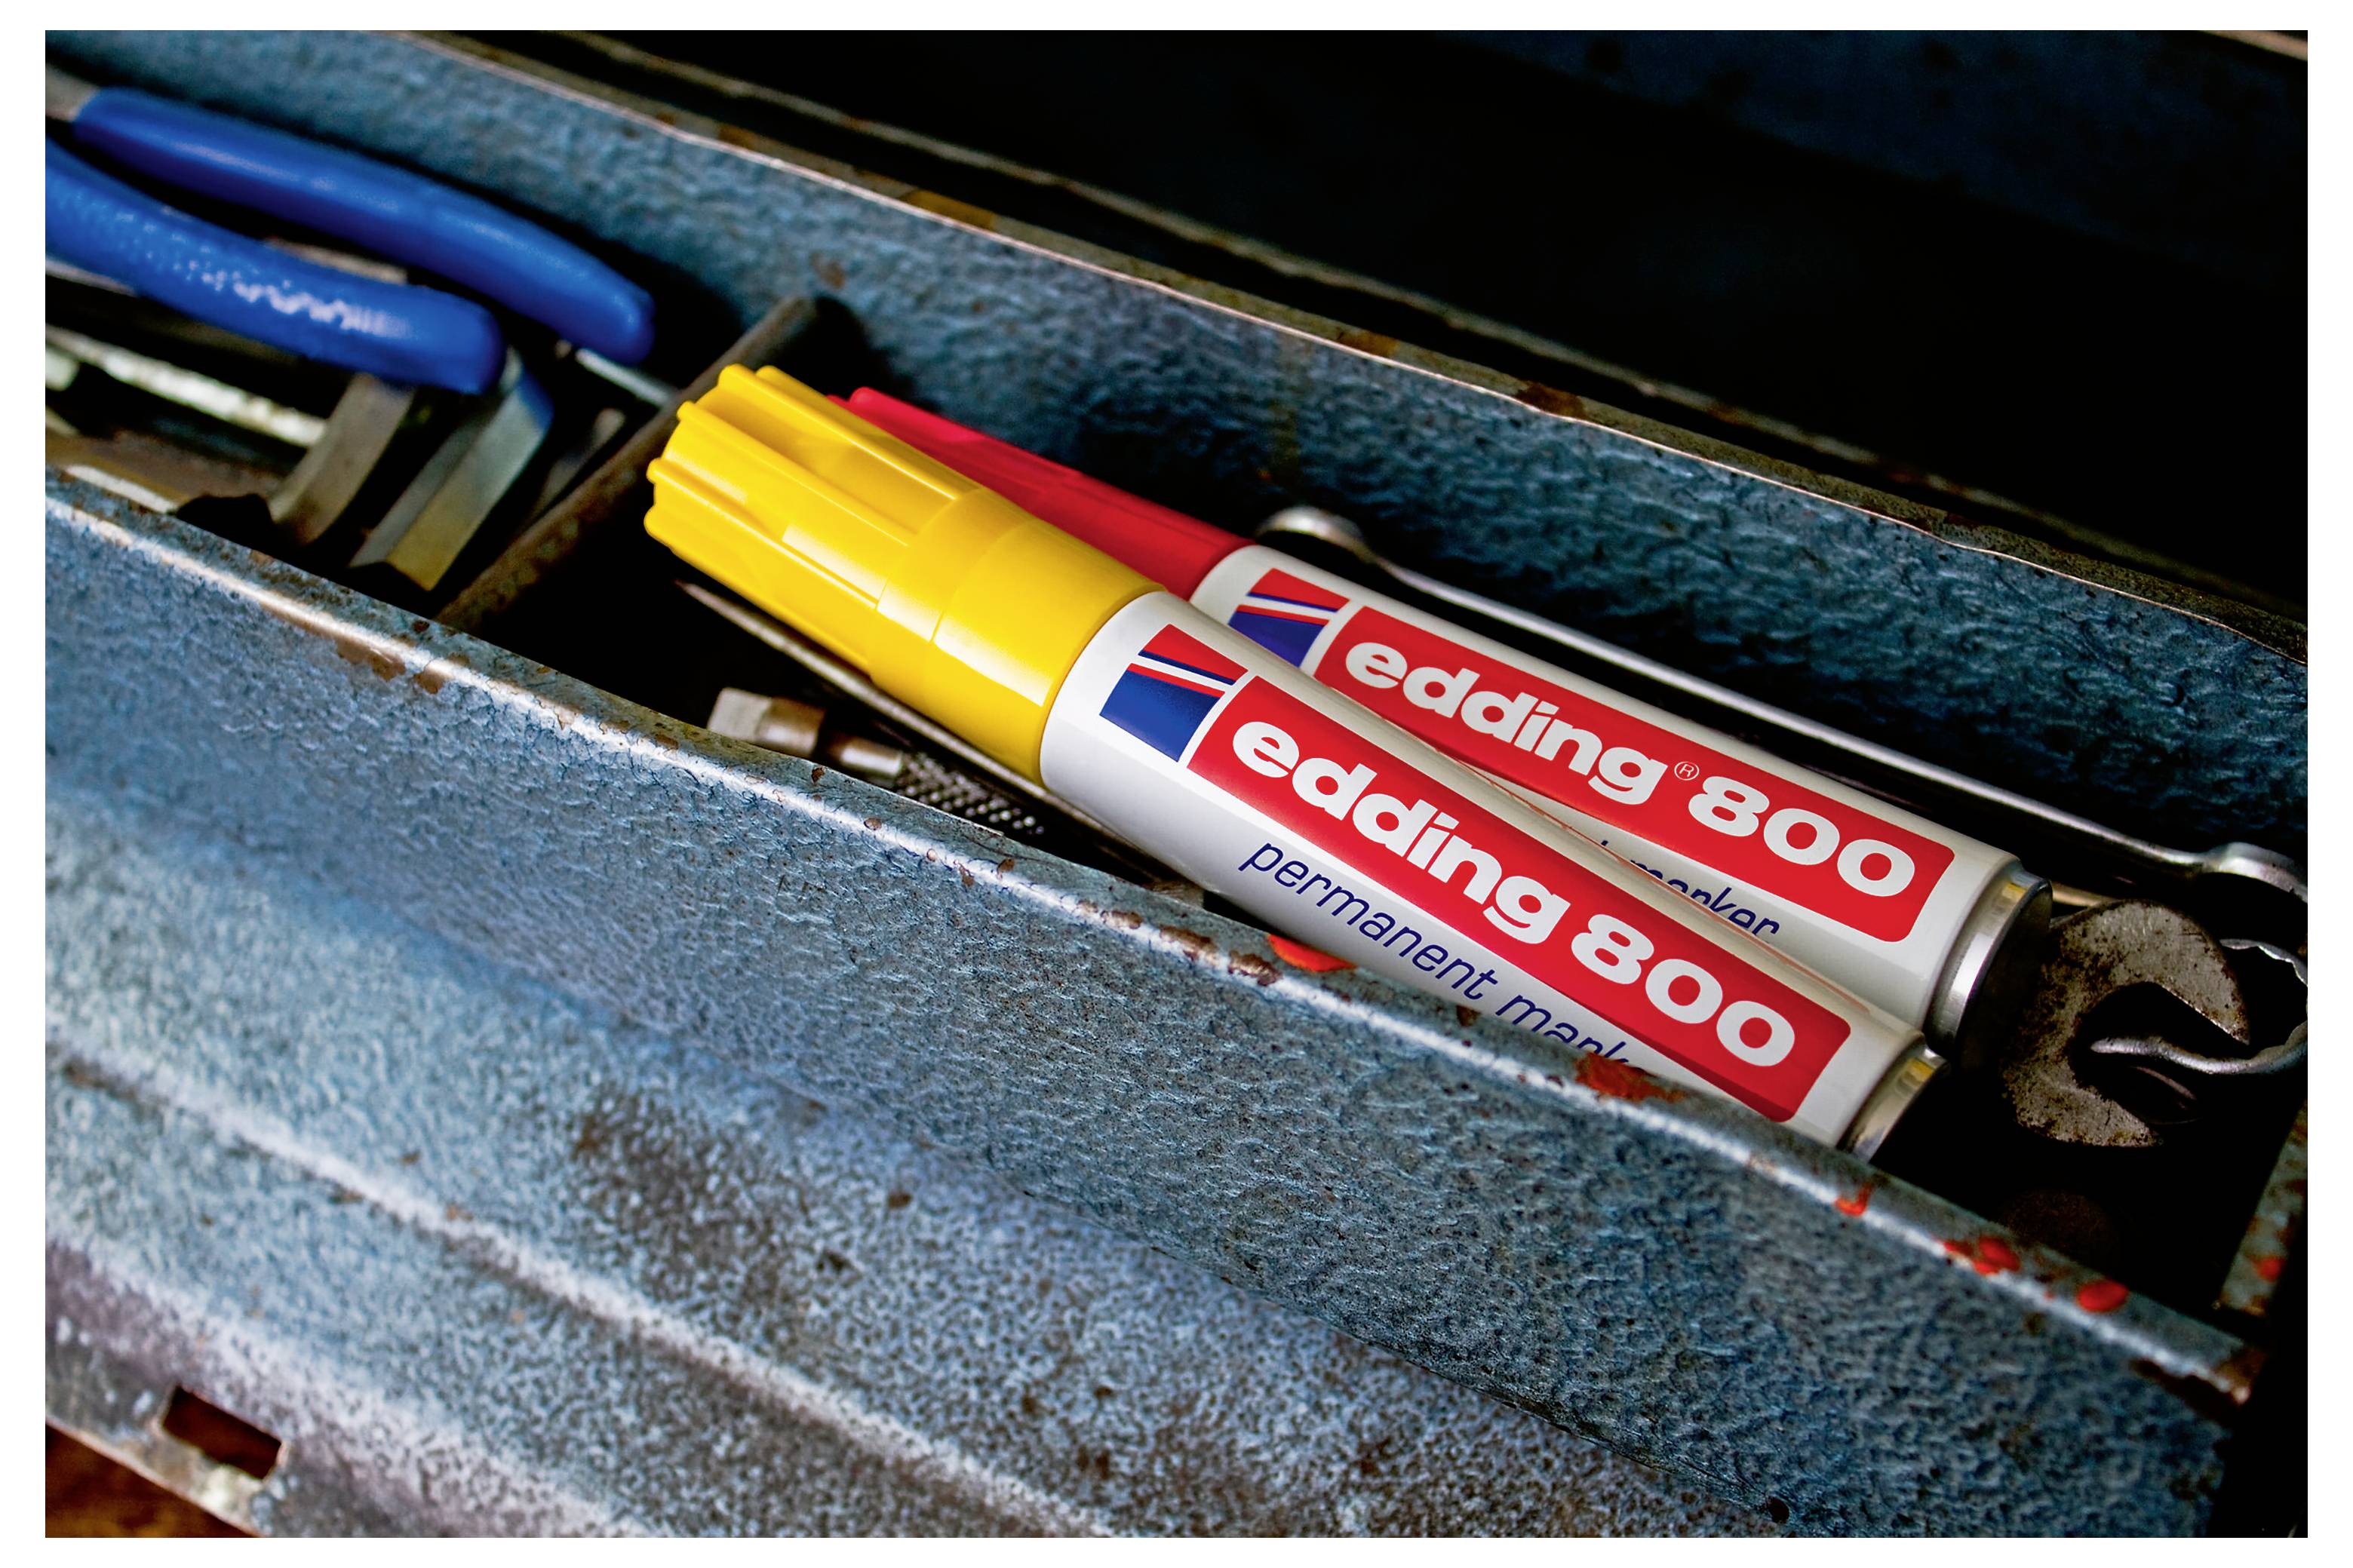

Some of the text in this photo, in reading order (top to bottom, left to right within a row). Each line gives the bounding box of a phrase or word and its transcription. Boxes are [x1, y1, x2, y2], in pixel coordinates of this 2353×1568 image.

[1232, 721, 1795, 1066] edding 800
[1688, 775, 1915, 898] 800
[1238, 842, 1499, 1001] permanent
